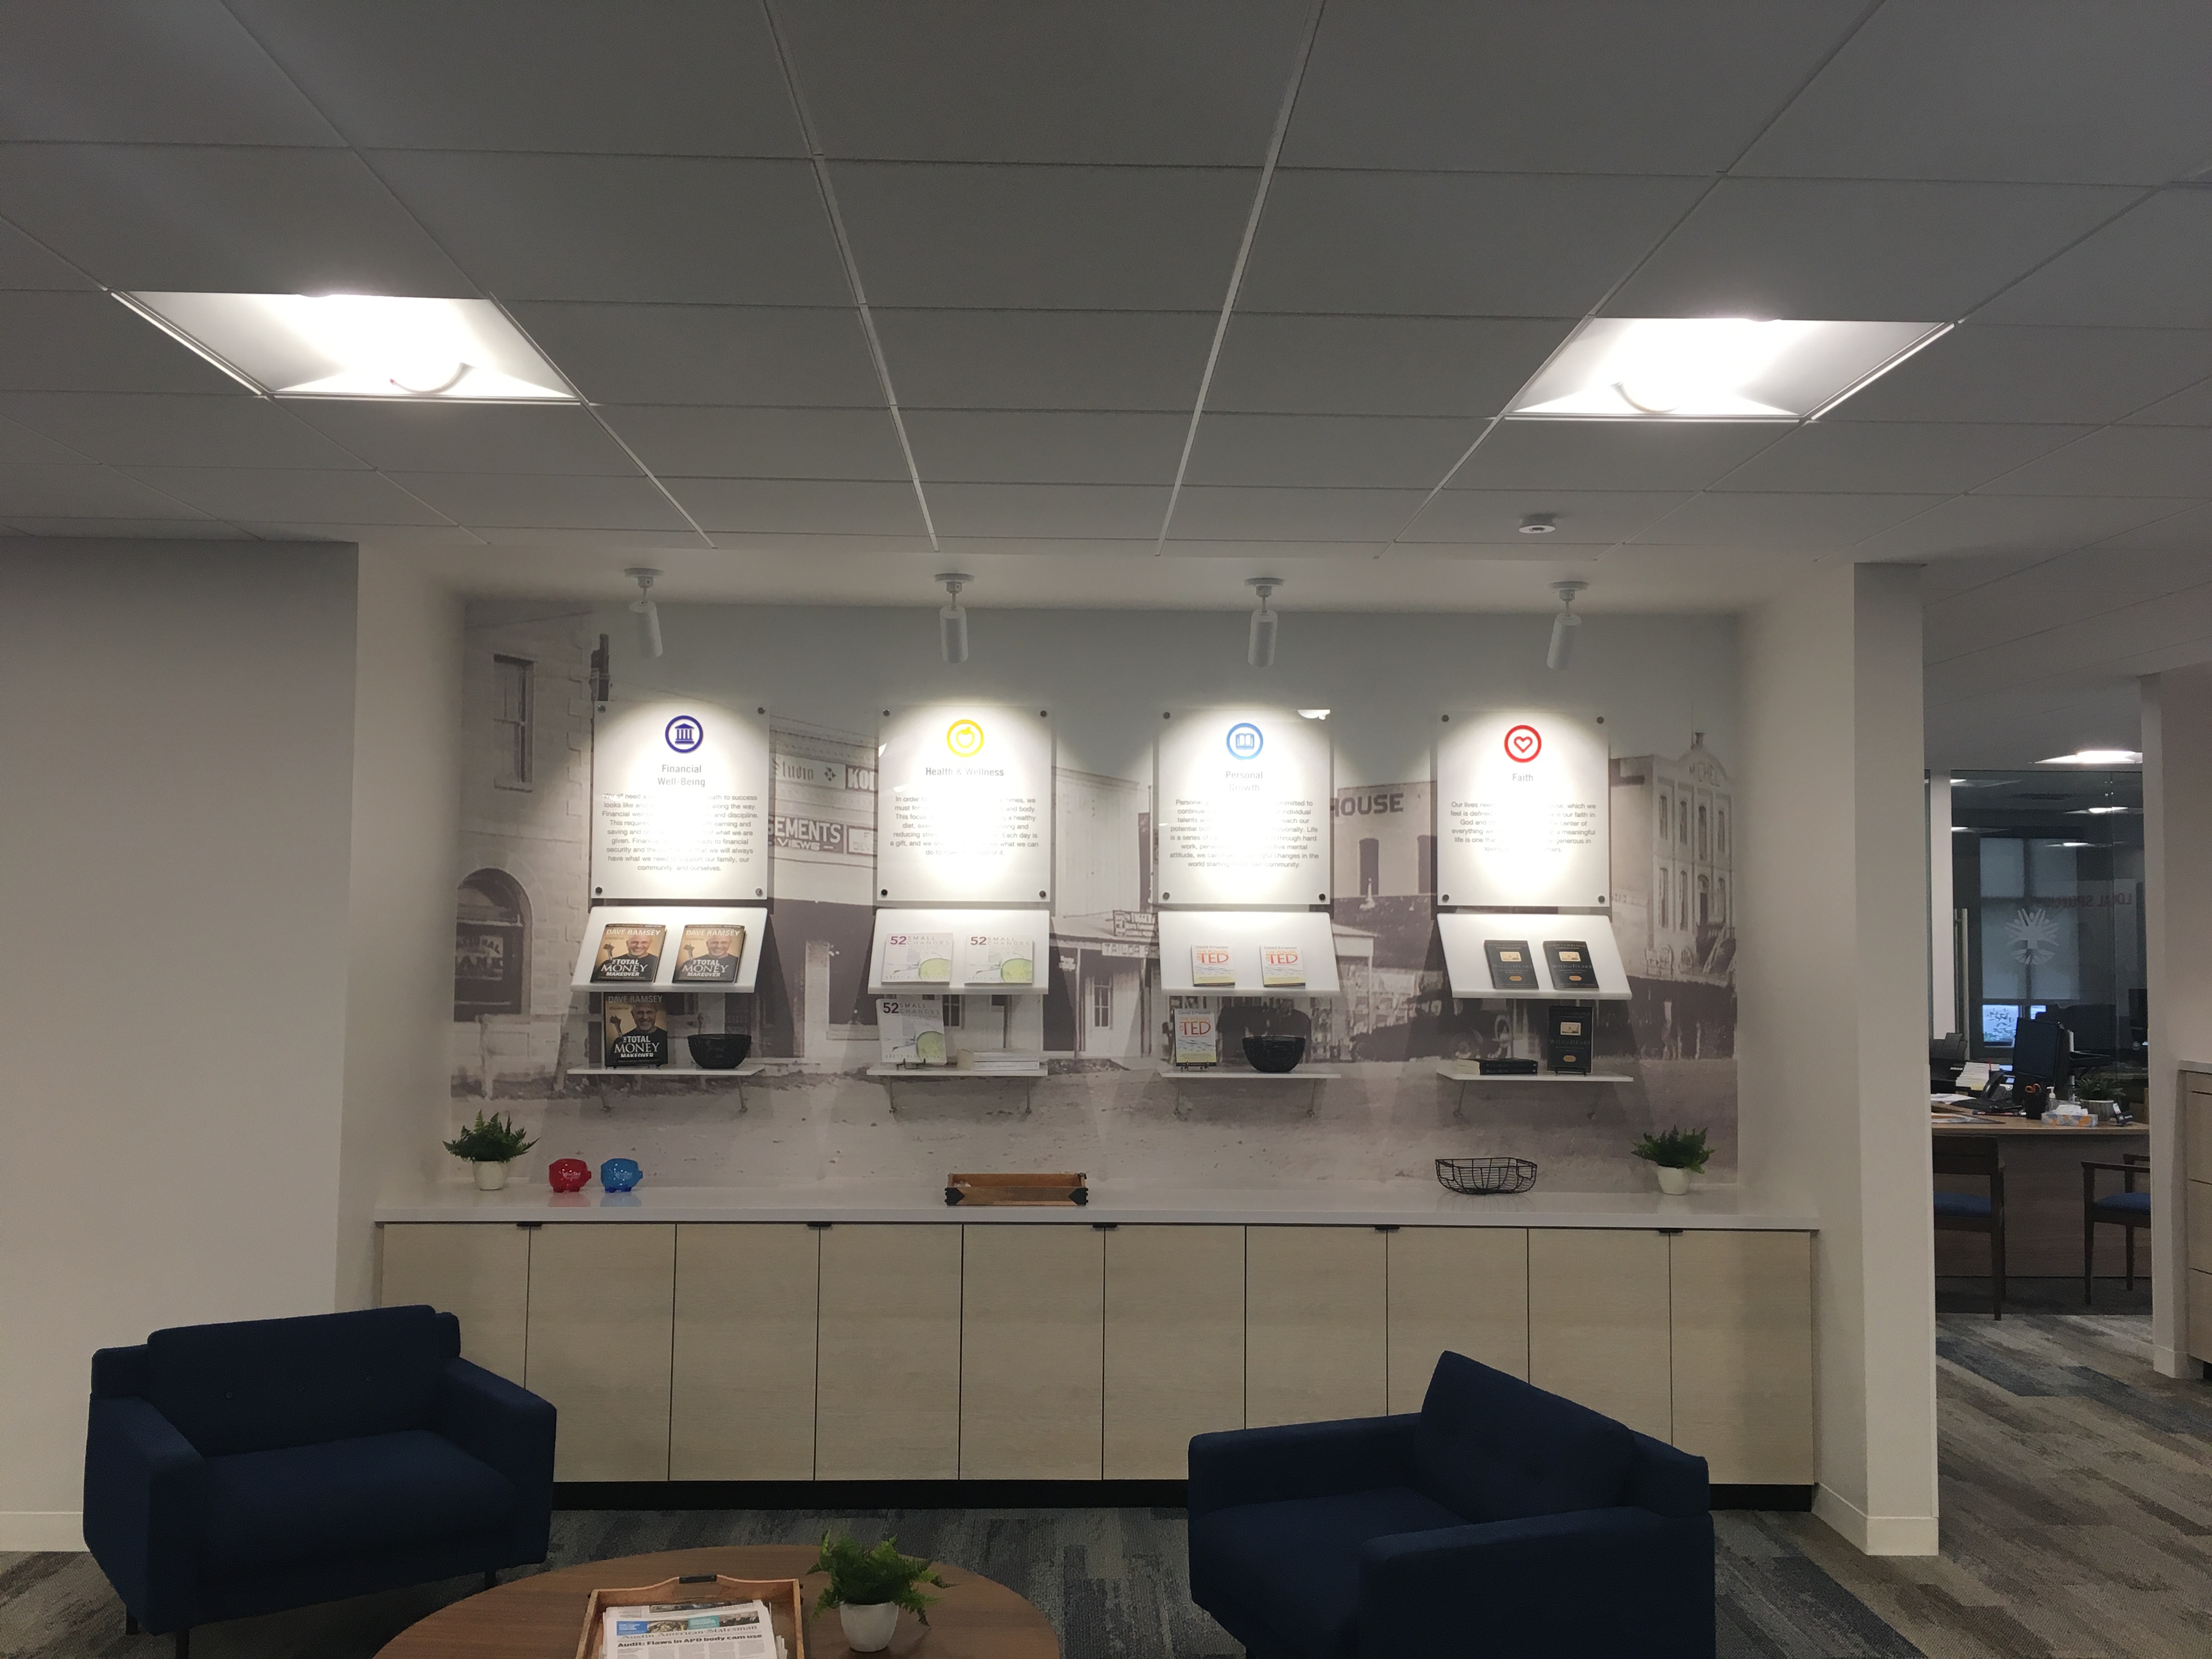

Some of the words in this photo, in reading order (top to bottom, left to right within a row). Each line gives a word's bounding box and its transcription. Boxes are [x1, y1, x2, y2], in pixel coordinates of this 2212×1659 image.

[926, 768, 952, 776] Health
[658, 777, 705, 787] Well-Being
[777, 838, 821, 850] VIEWS
[890, 936, 907, 945] 52
[970, 936, 987, 945] 52
[883, 1002, 899, 1014] 52
[1180, 1022, 1211, 1035] TED
[614, 1042, 660, 1053] MONEY
[658, 1625, 758, 1638] American-Statesman
